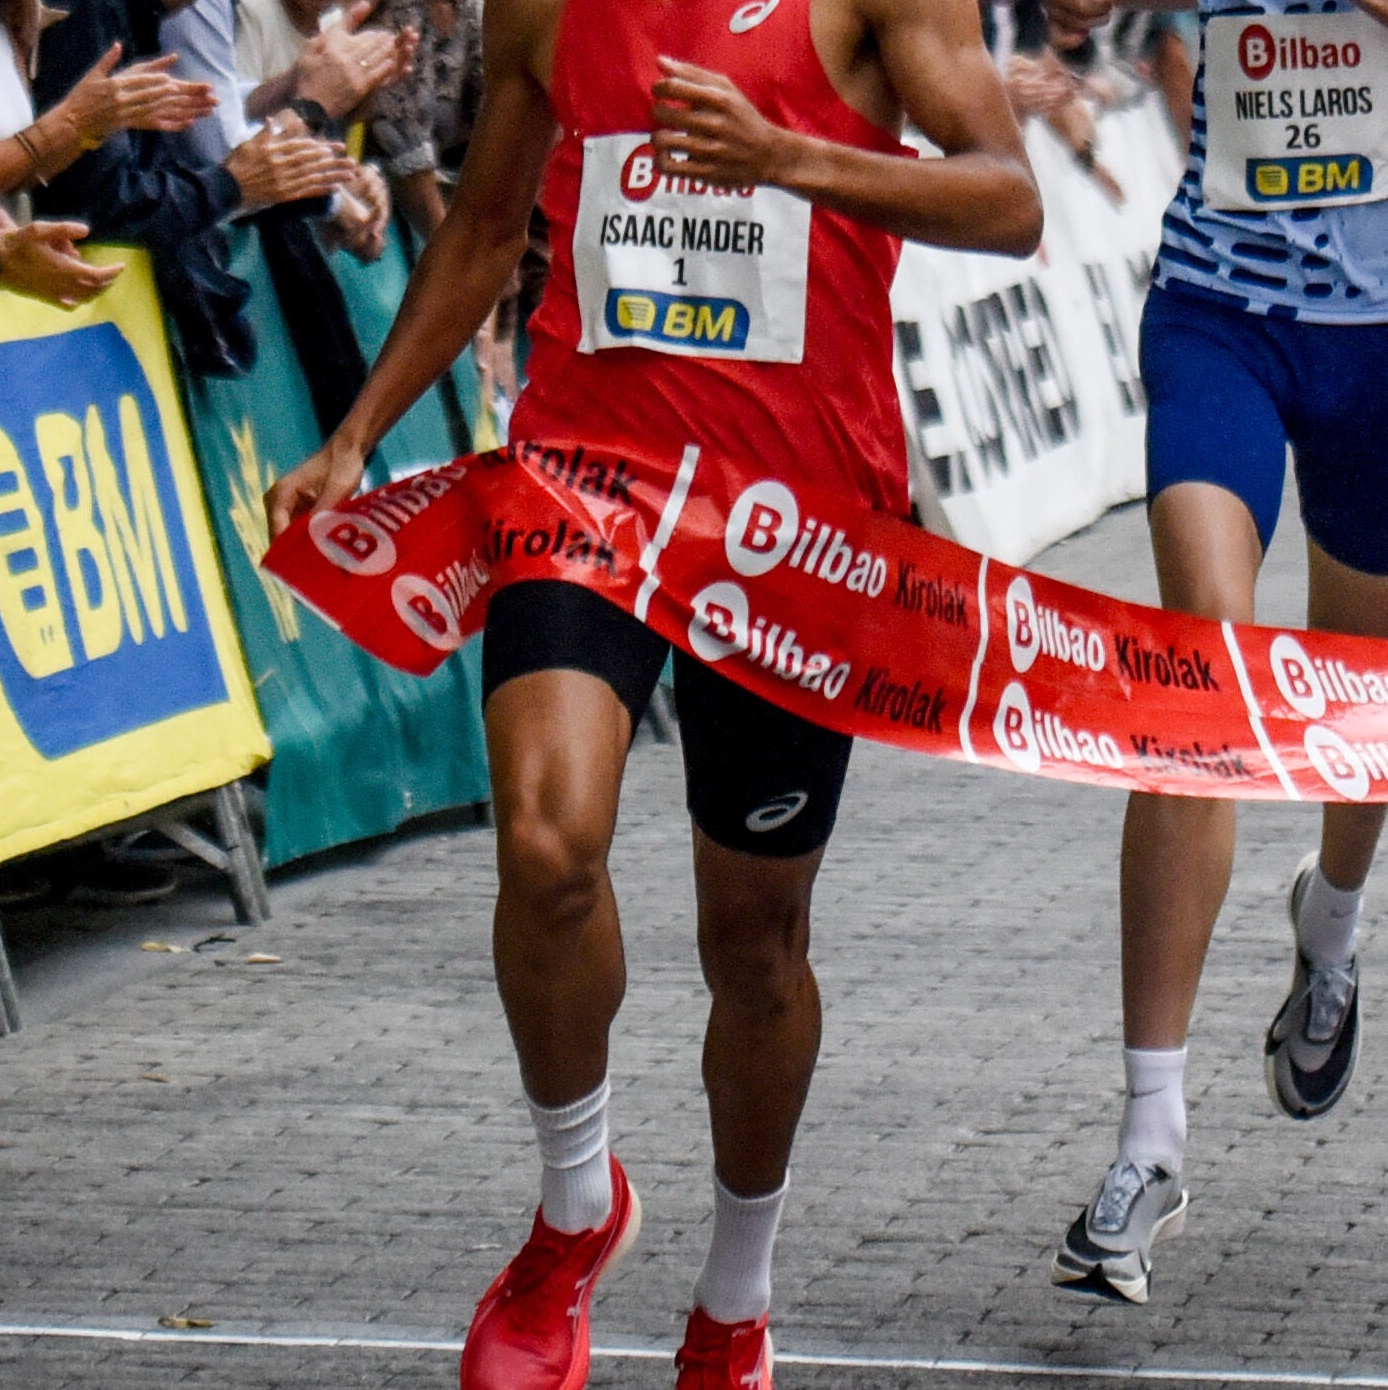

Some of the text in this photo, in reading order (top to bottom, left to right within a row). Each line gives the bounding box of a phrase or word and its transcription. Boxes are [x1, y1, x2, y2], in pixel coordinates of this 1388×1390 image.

[1242, 30, 1361, 74] Bilbao
[1234, 85, 1373, 121] NIELS LAROS
[1284, 123, 1322, 150] 26
[1296, 159, 1361, 194] BM
[600, 213, 765, 256] ISAAC NADER
[671, 257, 688, 287] 1
[662, 302, 737, 344] BM
[34, 392, 188, 663] BM
[732, 485, 969, 630] Bilbao Kirolak
[400, 550, 492, 643] Bilba
[1010, 586, 1221, 693] Bilbao Kirolak
[697, 590, 949, 736] Bilbao Kirolak
[997, 691, 1254, 781] Bilbao Kirolak
